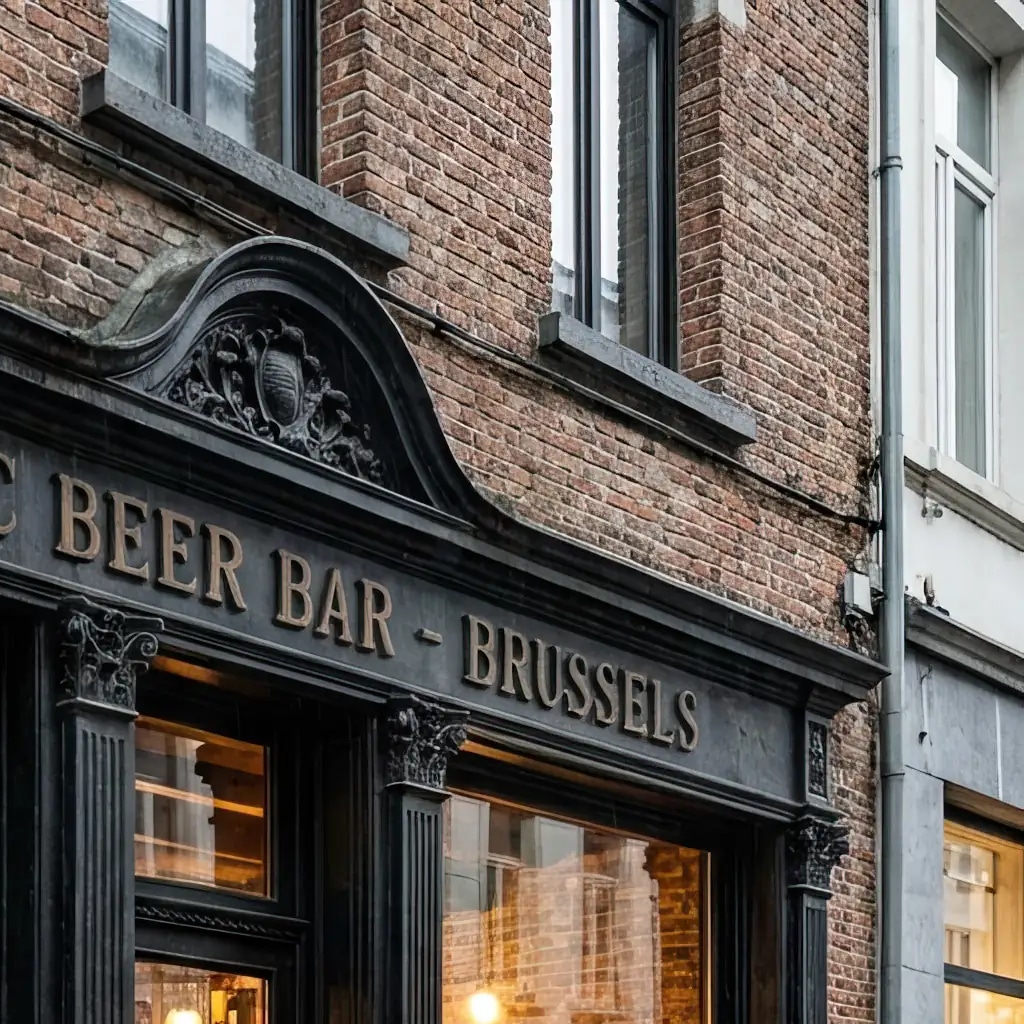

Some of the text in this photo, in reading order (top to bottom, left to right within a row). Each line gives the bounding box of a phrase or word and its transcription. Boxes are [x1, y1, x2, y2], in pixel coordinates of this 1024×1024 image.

[56, 472, 247, 612] BEER
[275, 549, 396, 658] BAR
[464, 614, 699, 753] BRUSSELS
